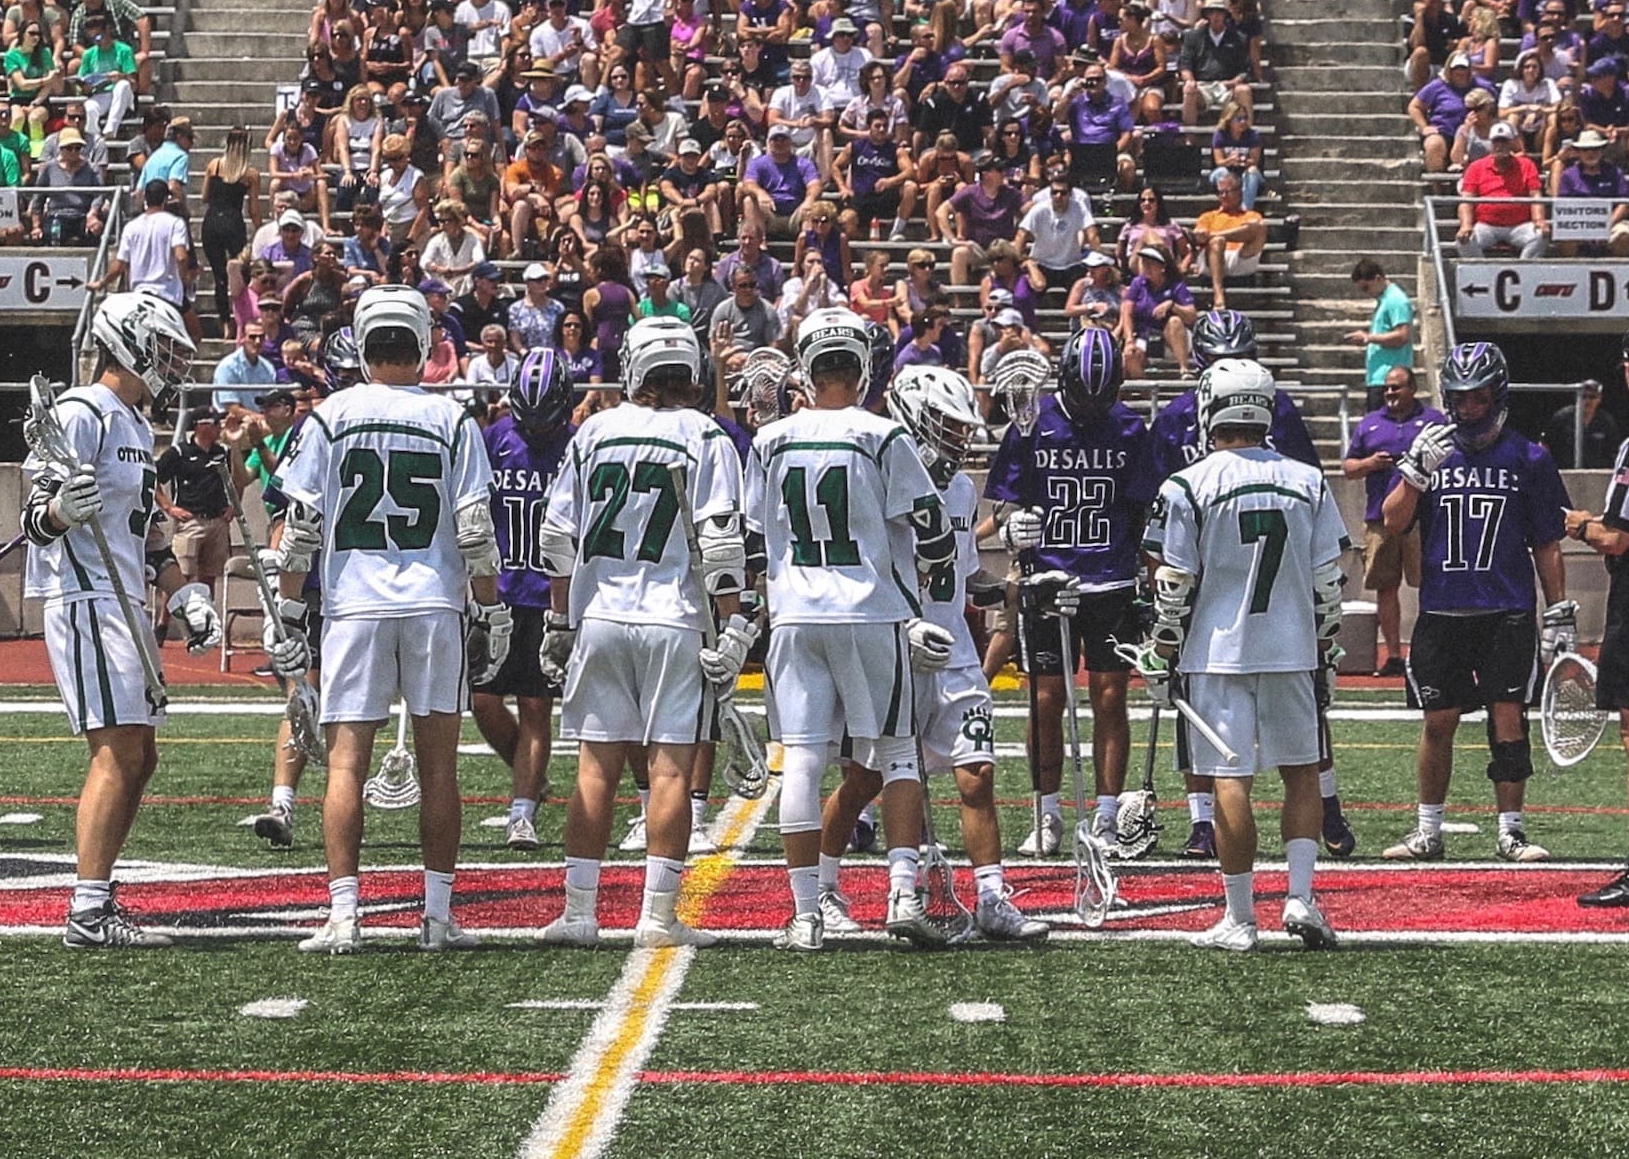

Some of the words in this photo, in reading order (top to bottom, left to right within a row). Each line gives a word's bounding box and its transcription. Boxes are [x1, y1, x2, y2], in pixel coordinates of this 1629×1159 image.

[1555, 207, 1609, 216] VISITORS
[1556, 221, 1607, 230] SECTION
[24, 262, 50, 304] C
[1495, 269, 1521, 312] C
[1589, 271, 1615, 311] D
[812, 328, 855, 342] BEARS
[1229, 396, 1269, 408] BEARS
[1035, 448, 1127, 470] DESALES
[335, 449, 446, 552] 25
[493, 470, 557, 492] DESA
[582, 461, 688, 564] 27
[781, 466, 853, 567] 11
[1040, 476, 1116, 548] 22
[1440, 494, 1507, 571] 17
[1239, 508, 1289, 616] 7
